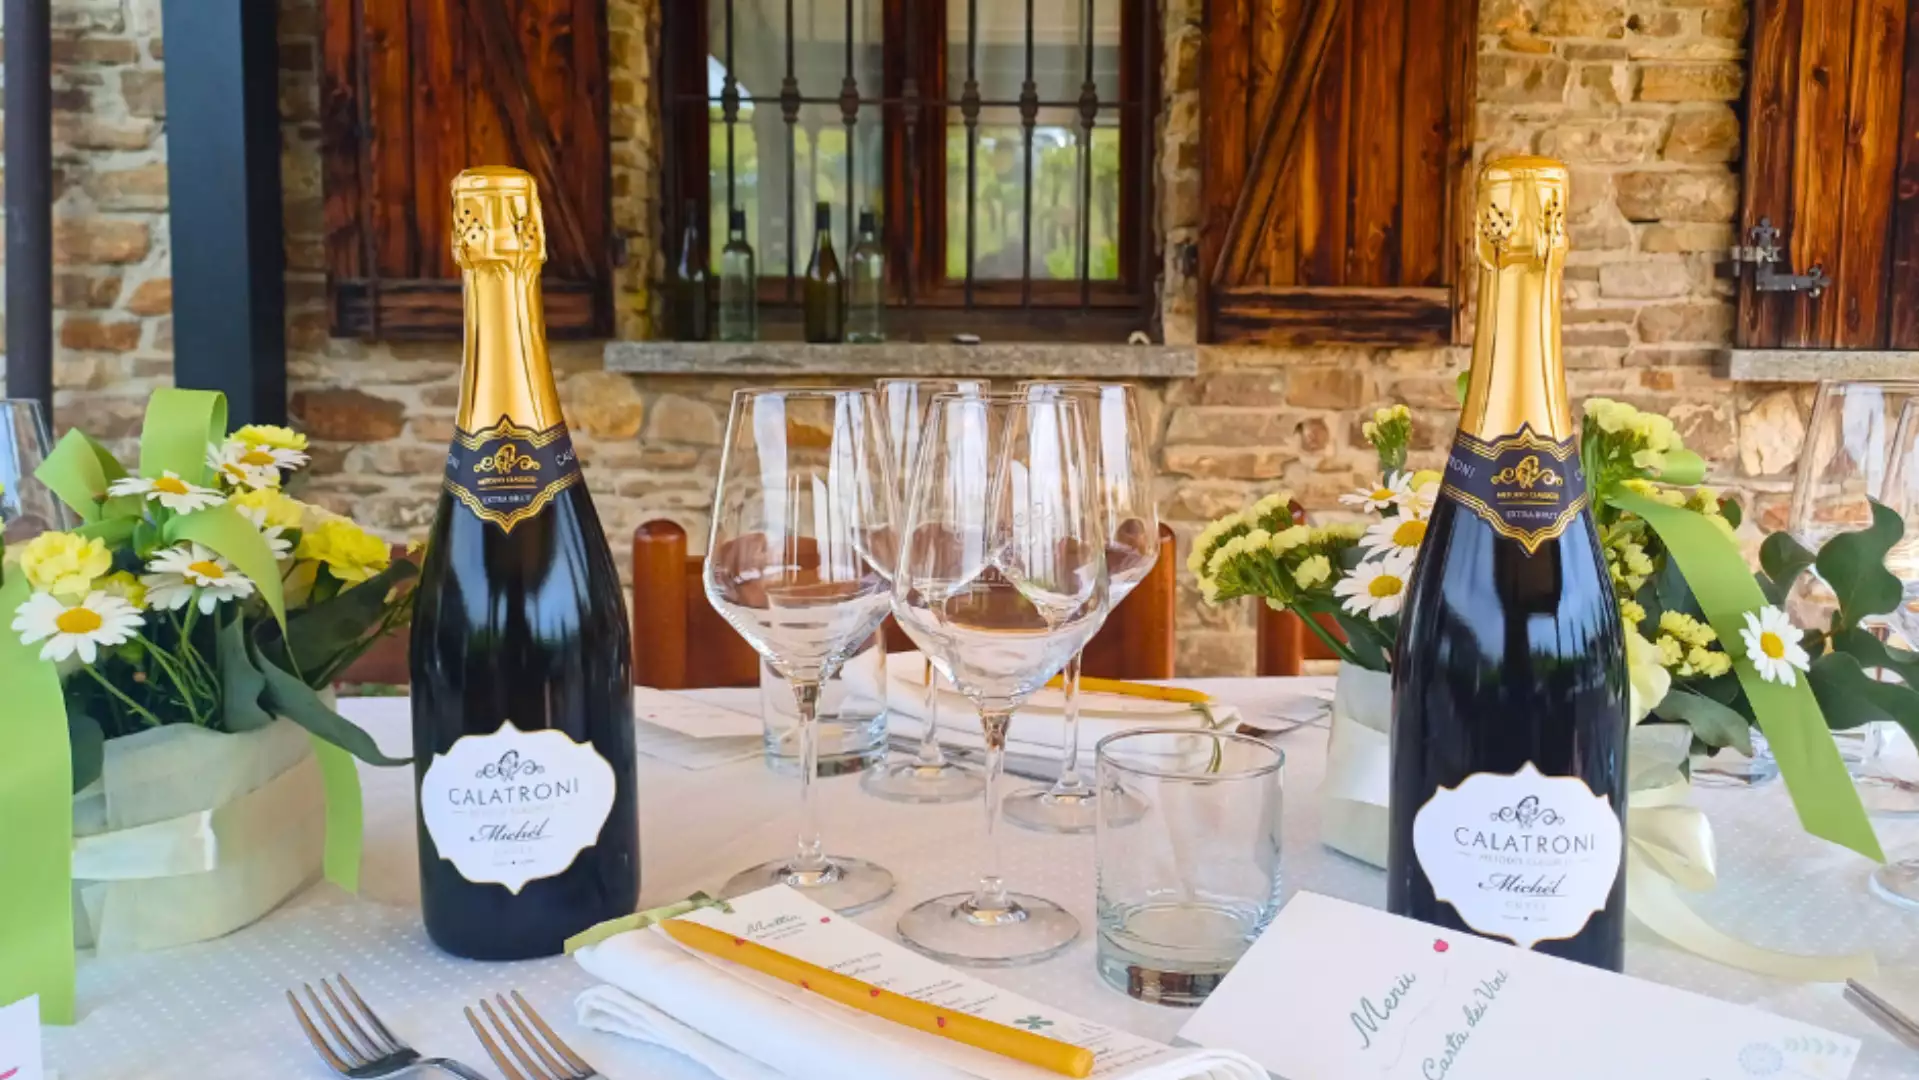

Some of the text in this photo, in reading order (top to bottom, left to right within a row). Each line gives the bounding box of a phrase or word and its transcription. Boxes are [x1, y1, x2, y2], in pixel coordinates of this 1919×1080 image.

[449, 777, 579, 806] CALATRONI
[1454, 826, 1595, 854] CALATRONI
[1422, 969, 1508, 1080] Carta dei Vini
